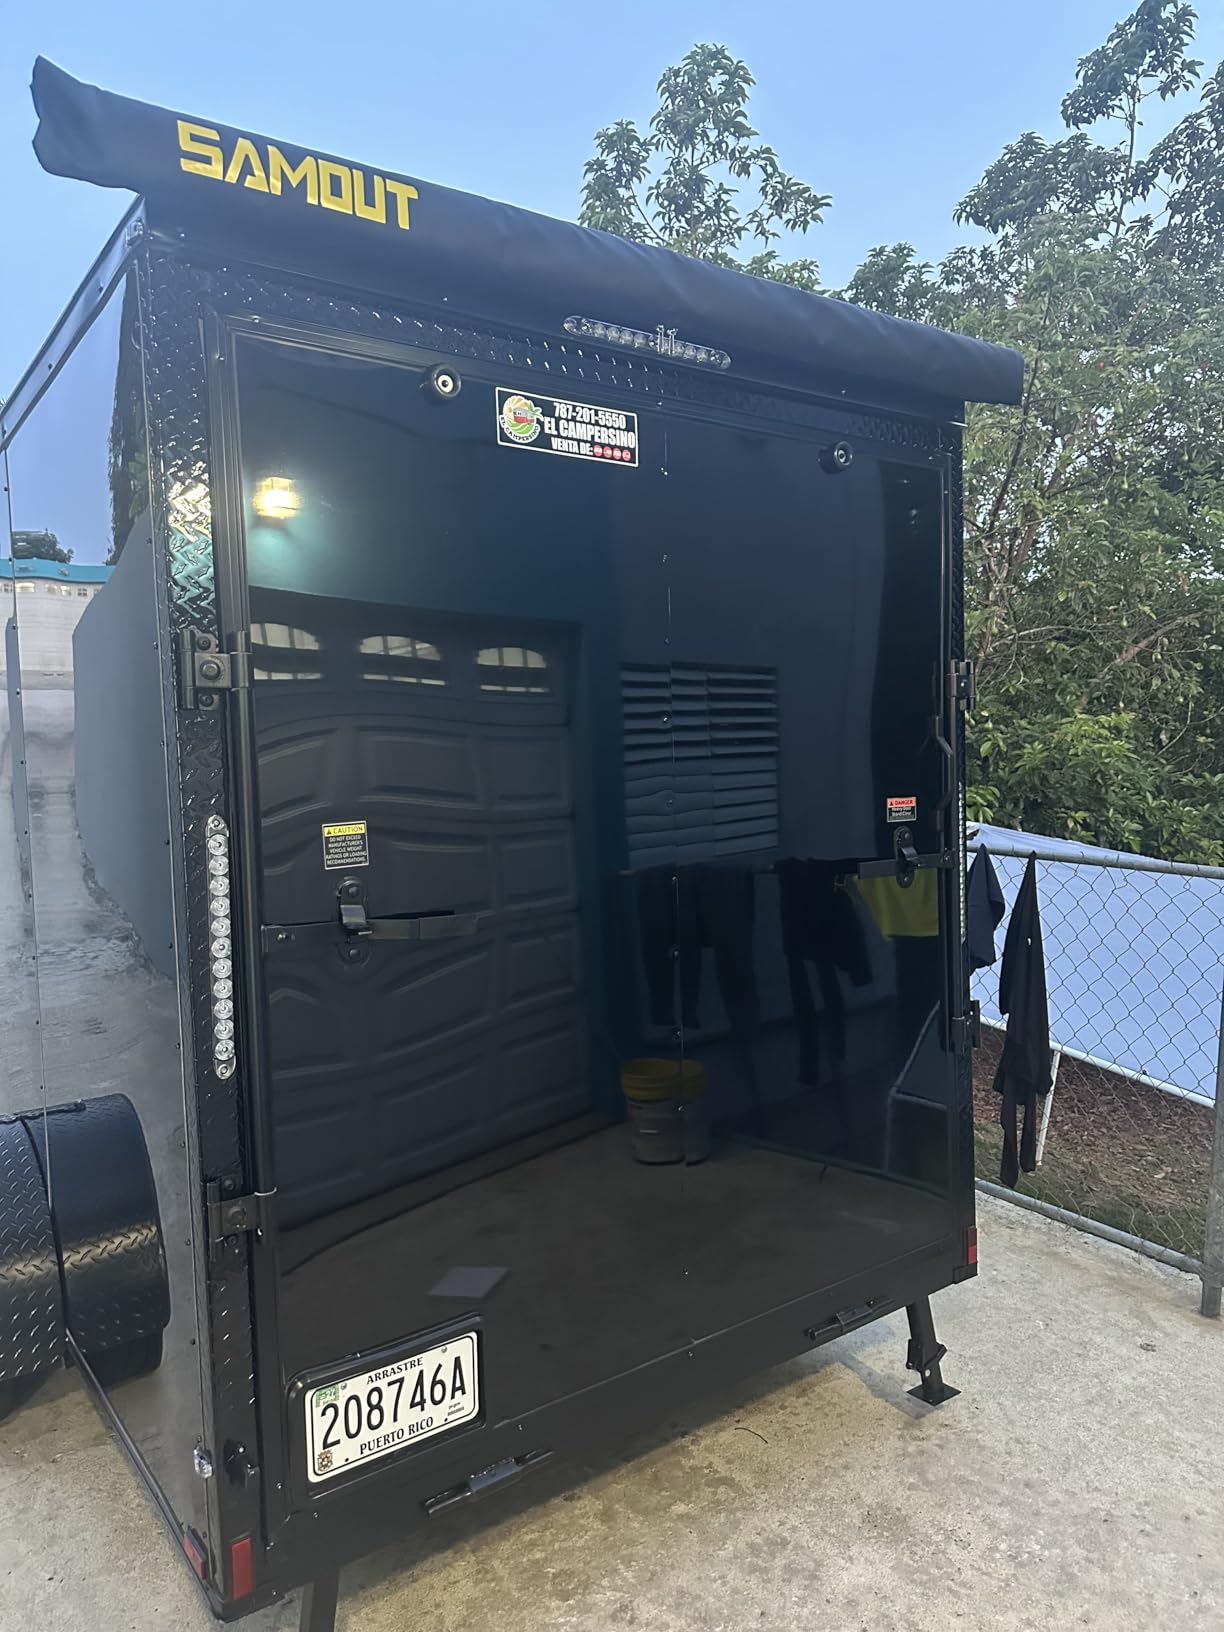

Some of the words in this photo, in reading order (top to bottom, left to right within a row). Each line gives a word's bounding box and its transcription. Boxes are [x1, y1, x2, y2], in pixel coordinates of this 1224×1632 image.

[177, 120, 419, 230] SAMOUT
[553, 402, 626, 429] 787-201-5550
[544, 416, 558, 435] EL
[559, 419, 636, 449] CAMPERSINO
[551, 437, 579, 454] VENTA
[580, 442, 594, 456] DE:
[333, 826, 363, 835] CAUTION
[366, 1357, 424, 1385] ARRASTRE
[320, 1355, 467, 1450] 208746A
[359, 1428, 405, 1455] PUERTO
[408, 1416, 434, 1436] RICO
